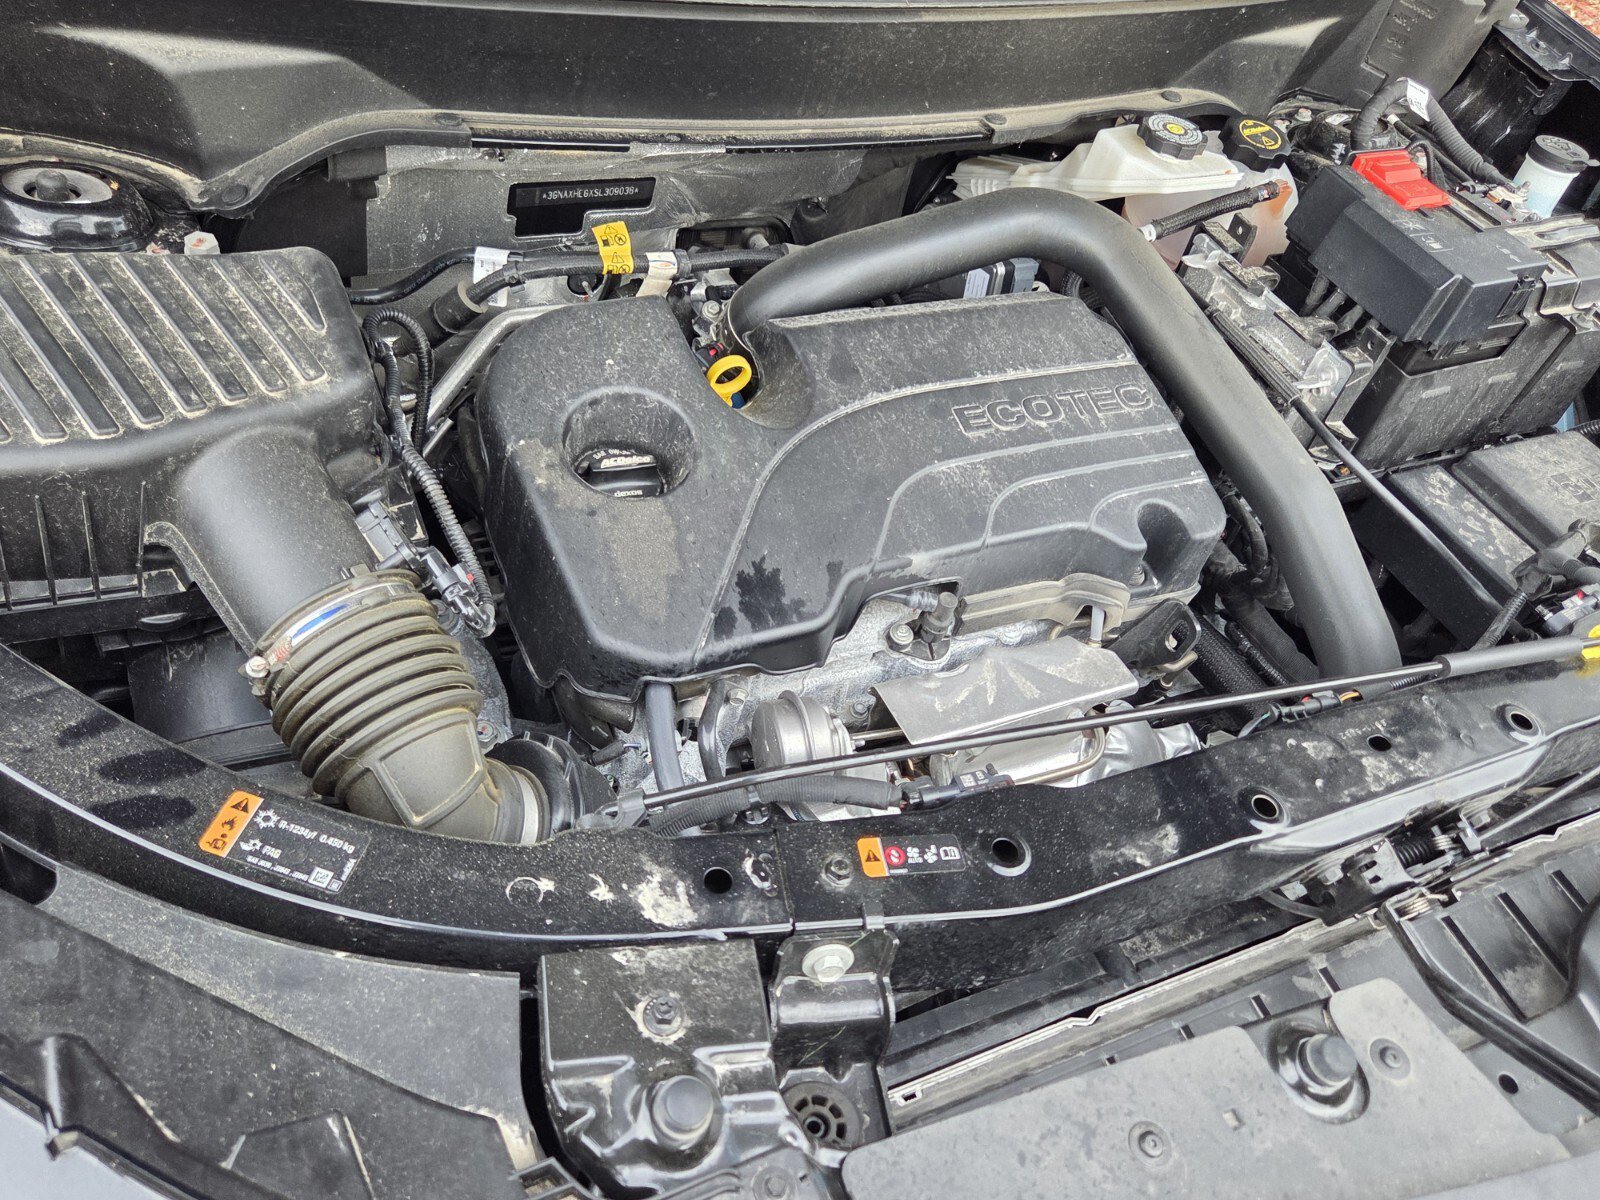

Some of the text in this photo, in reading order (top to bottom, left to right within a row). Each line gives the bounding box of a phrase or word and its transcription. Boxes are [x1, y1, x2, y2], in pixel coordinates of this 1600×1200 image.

[952, 382, 1153, 437] ECOTEC
[601, 455, 651, 468] ACDelco
[614, 489, 643, 498] dexos
[343, 842, 356, 854] kg
